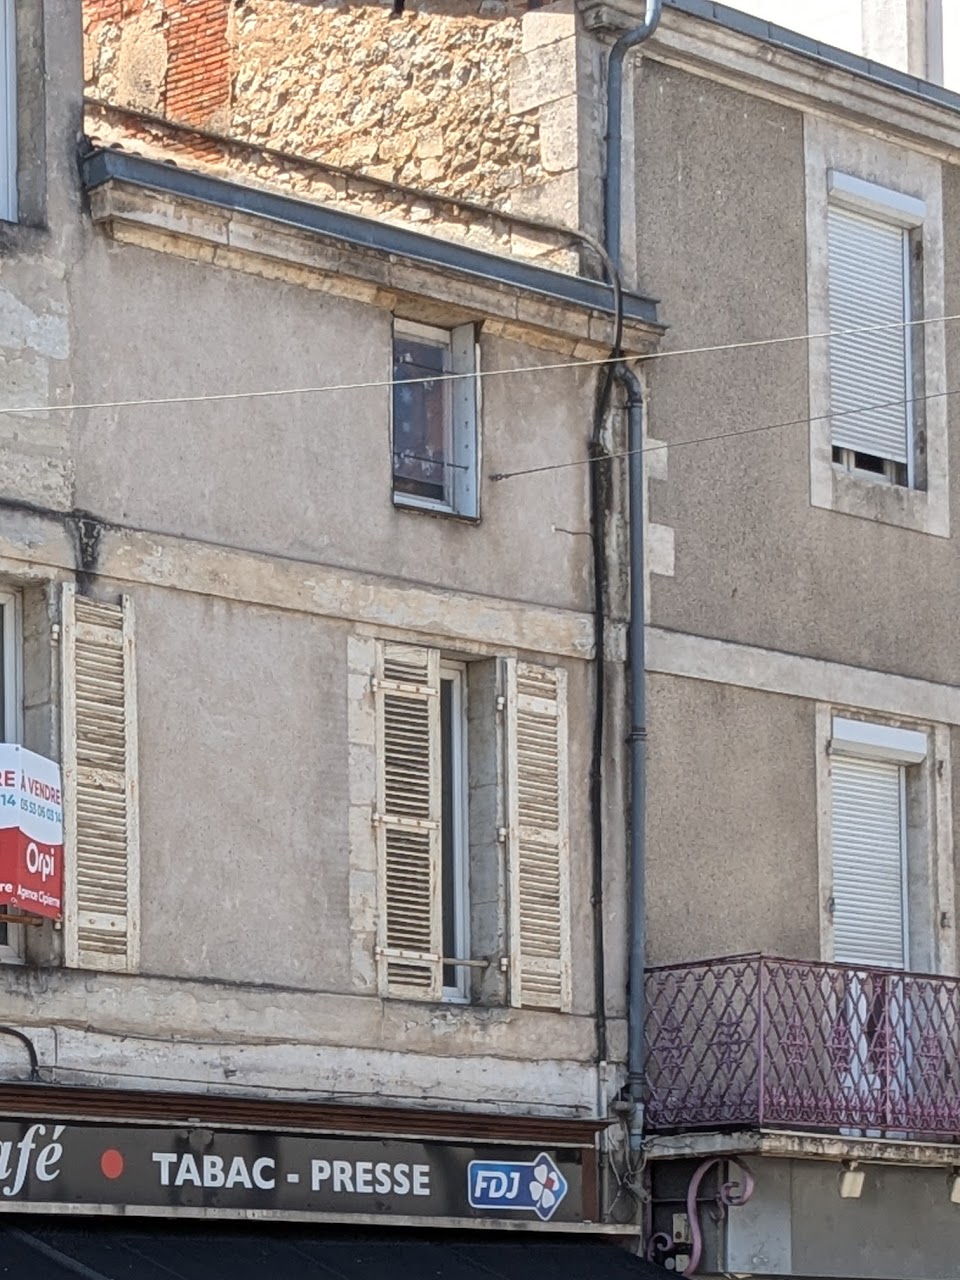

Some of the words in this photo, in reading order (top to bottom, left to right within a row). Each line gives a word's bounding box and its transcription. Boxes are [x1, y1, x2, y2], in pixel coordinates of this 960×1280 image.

[0, 794, 16, 806] 14
[28, 777, 61, 805] VENDRE
[26, 842, 55, 882] Orpi
[152, 1153, 276, 1190] TABAC
[286, 1174, 300, 1183] -
[311, 1159, 431, 1196] PRESSE
[474, 1170, 520, 1199] FDJ
